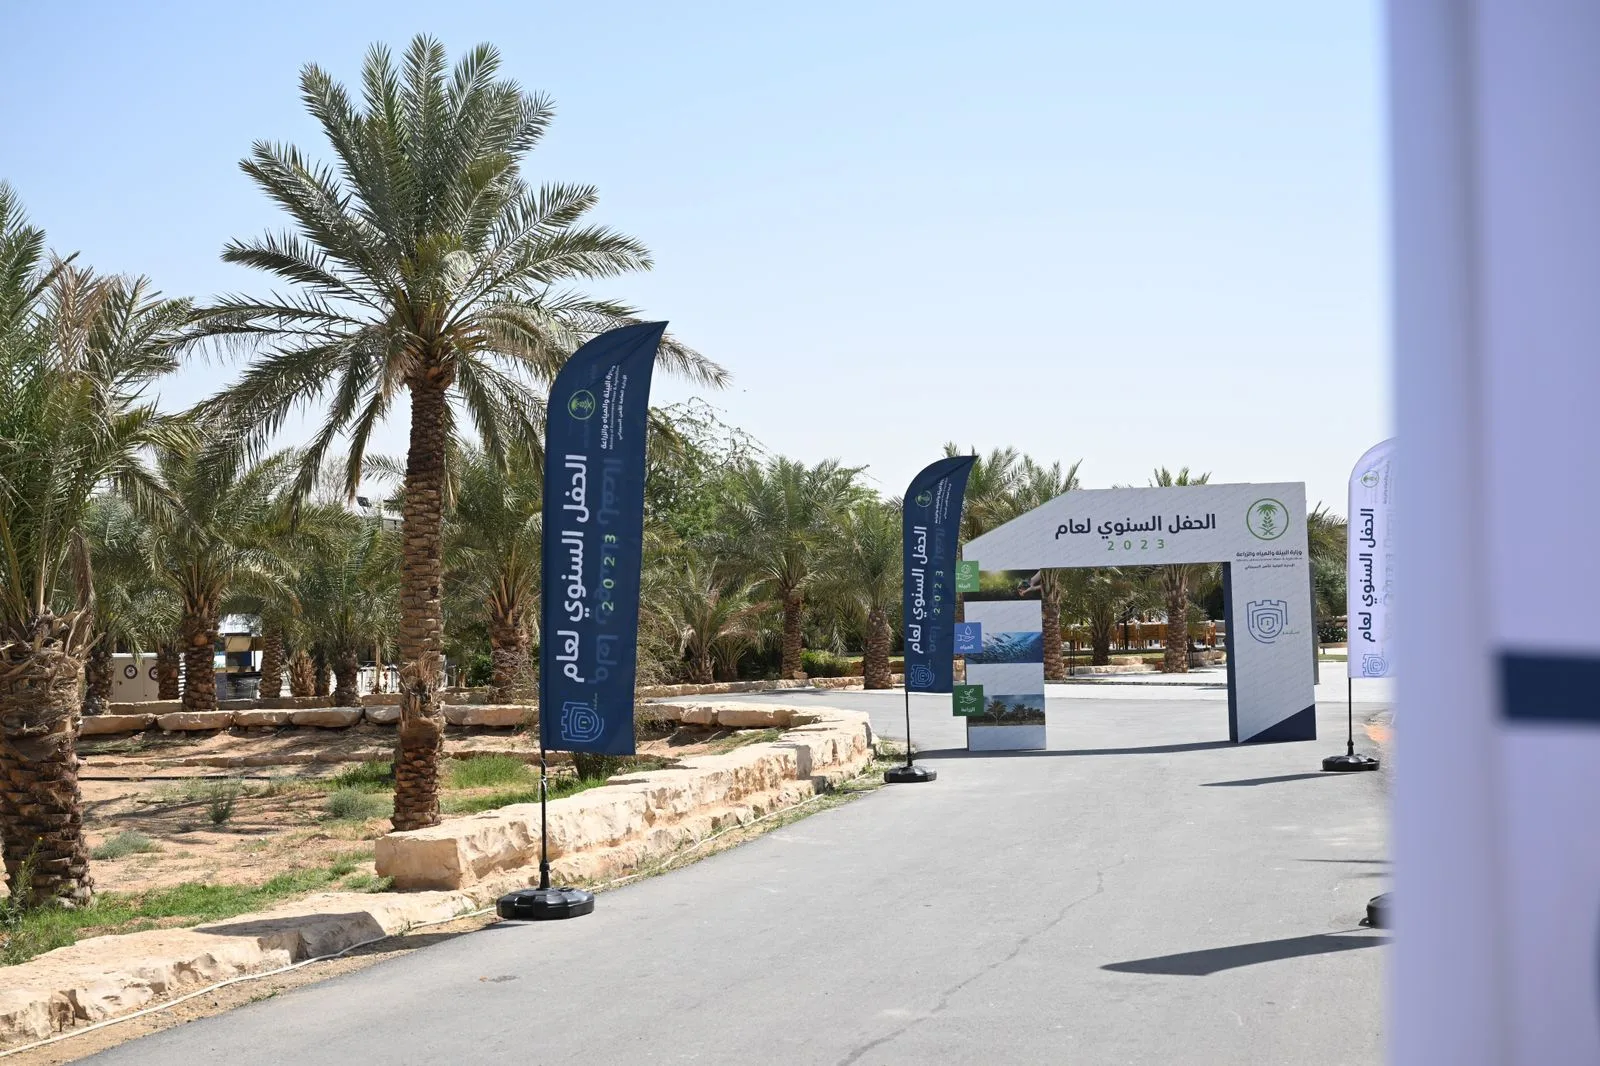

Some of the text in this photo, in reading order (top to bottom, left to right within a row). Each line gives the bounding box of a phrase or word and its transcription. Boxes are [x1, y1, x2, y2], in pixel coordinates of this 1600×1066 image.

[602, 399, 610, 424] والمياه
[600, 424, 608, 449] والزراعة
[1055, 514, 1216, 539] الحفل السنوي لعام
[1107, 539, 1164, 550] 2023
[556, 454, 590, 682] الحفل السنوي لعام
[602, 534, 616, 612] 2023
[908, 526, 928, 654] الحفل السنوي لعام
[1358, 508, 1378, 642] الحفل السنوي لعام
[934, 570, 944, 614] 2023
